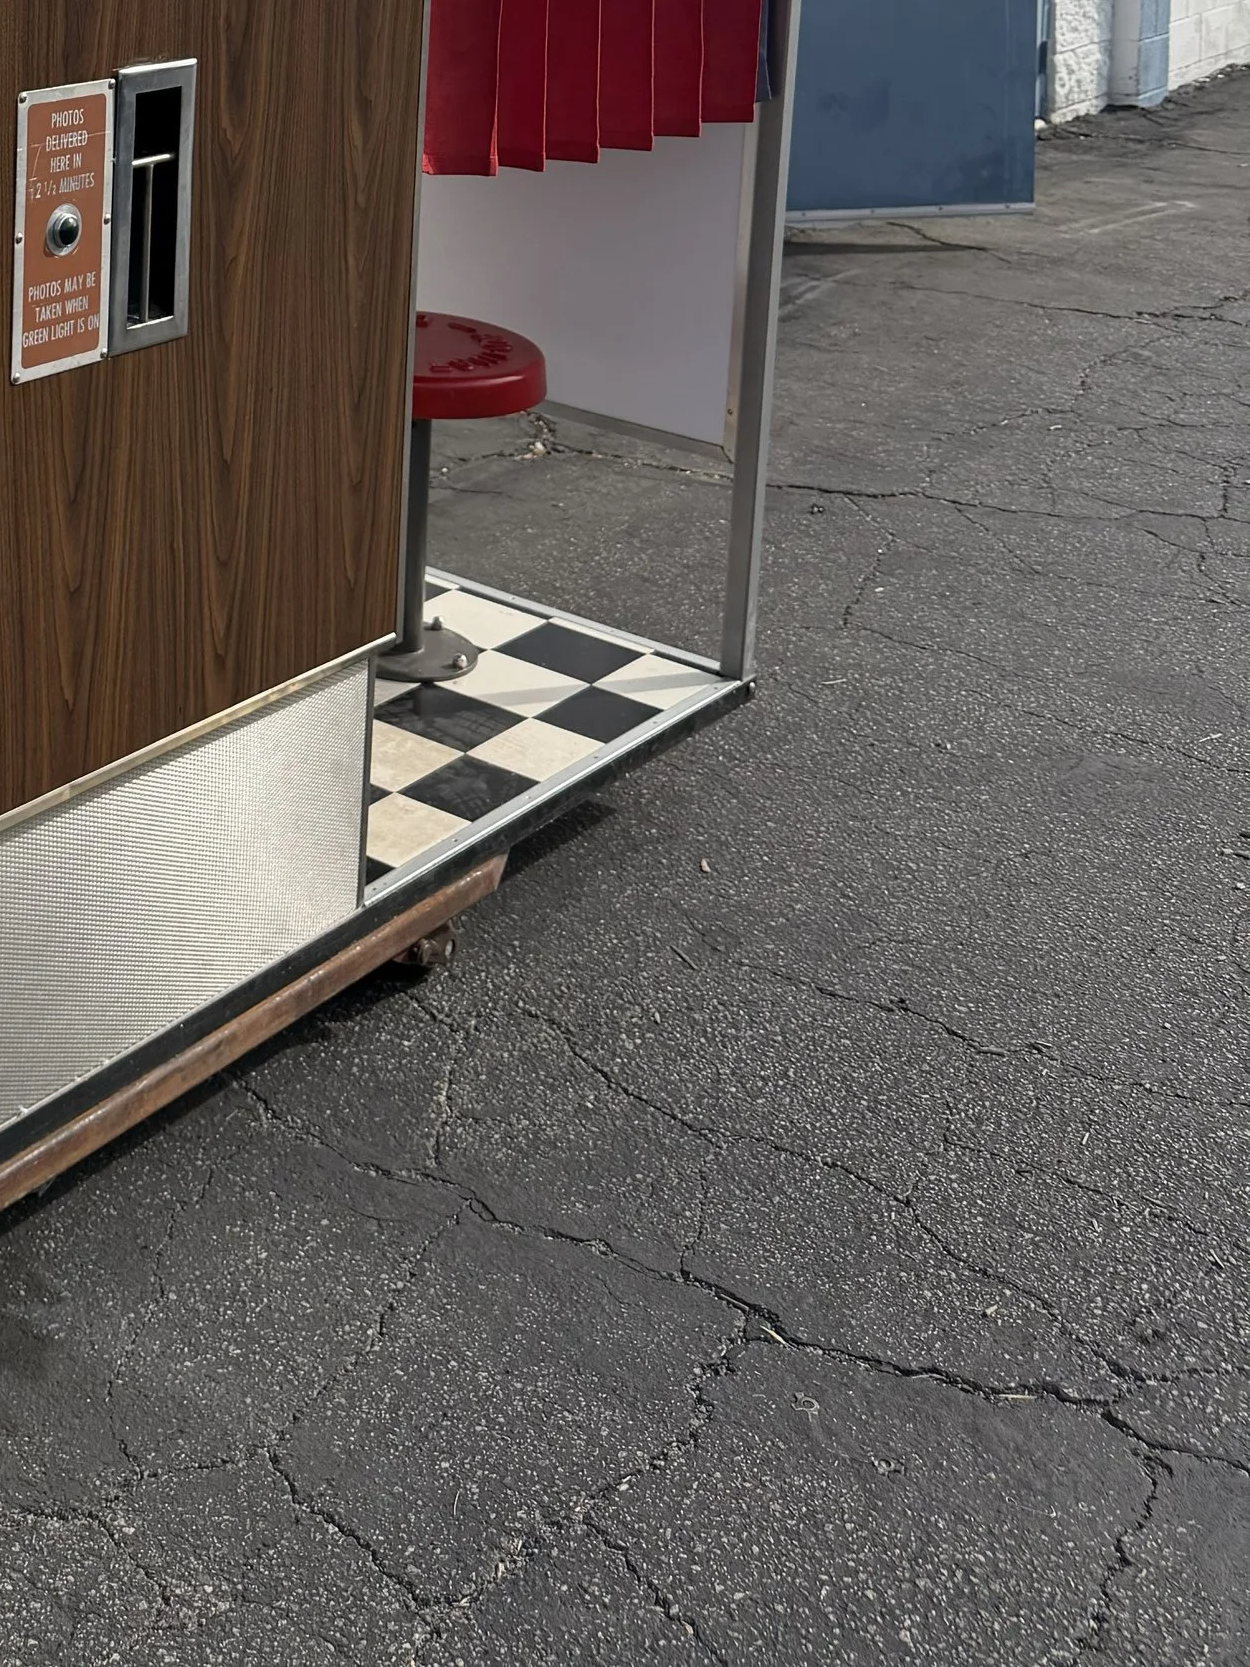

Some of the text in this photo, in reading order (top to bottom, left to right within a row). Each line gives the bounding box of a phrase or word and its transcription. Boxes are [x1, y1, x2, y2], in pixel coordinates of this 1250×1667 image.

[51, 108, 85, 128] PHOTOS
[45, 130, 88, 152] DELIVERED
[50, 152, 82, 173] HERE IN
[59, 172, 95, 194] MINUTES
[28, 271, 96, 302] PHOTOS MAY BE
[35, 295, 89, 322] TAKEN WHEN
[22, 313, 100, 348] GREEN LIGHT IS ON
